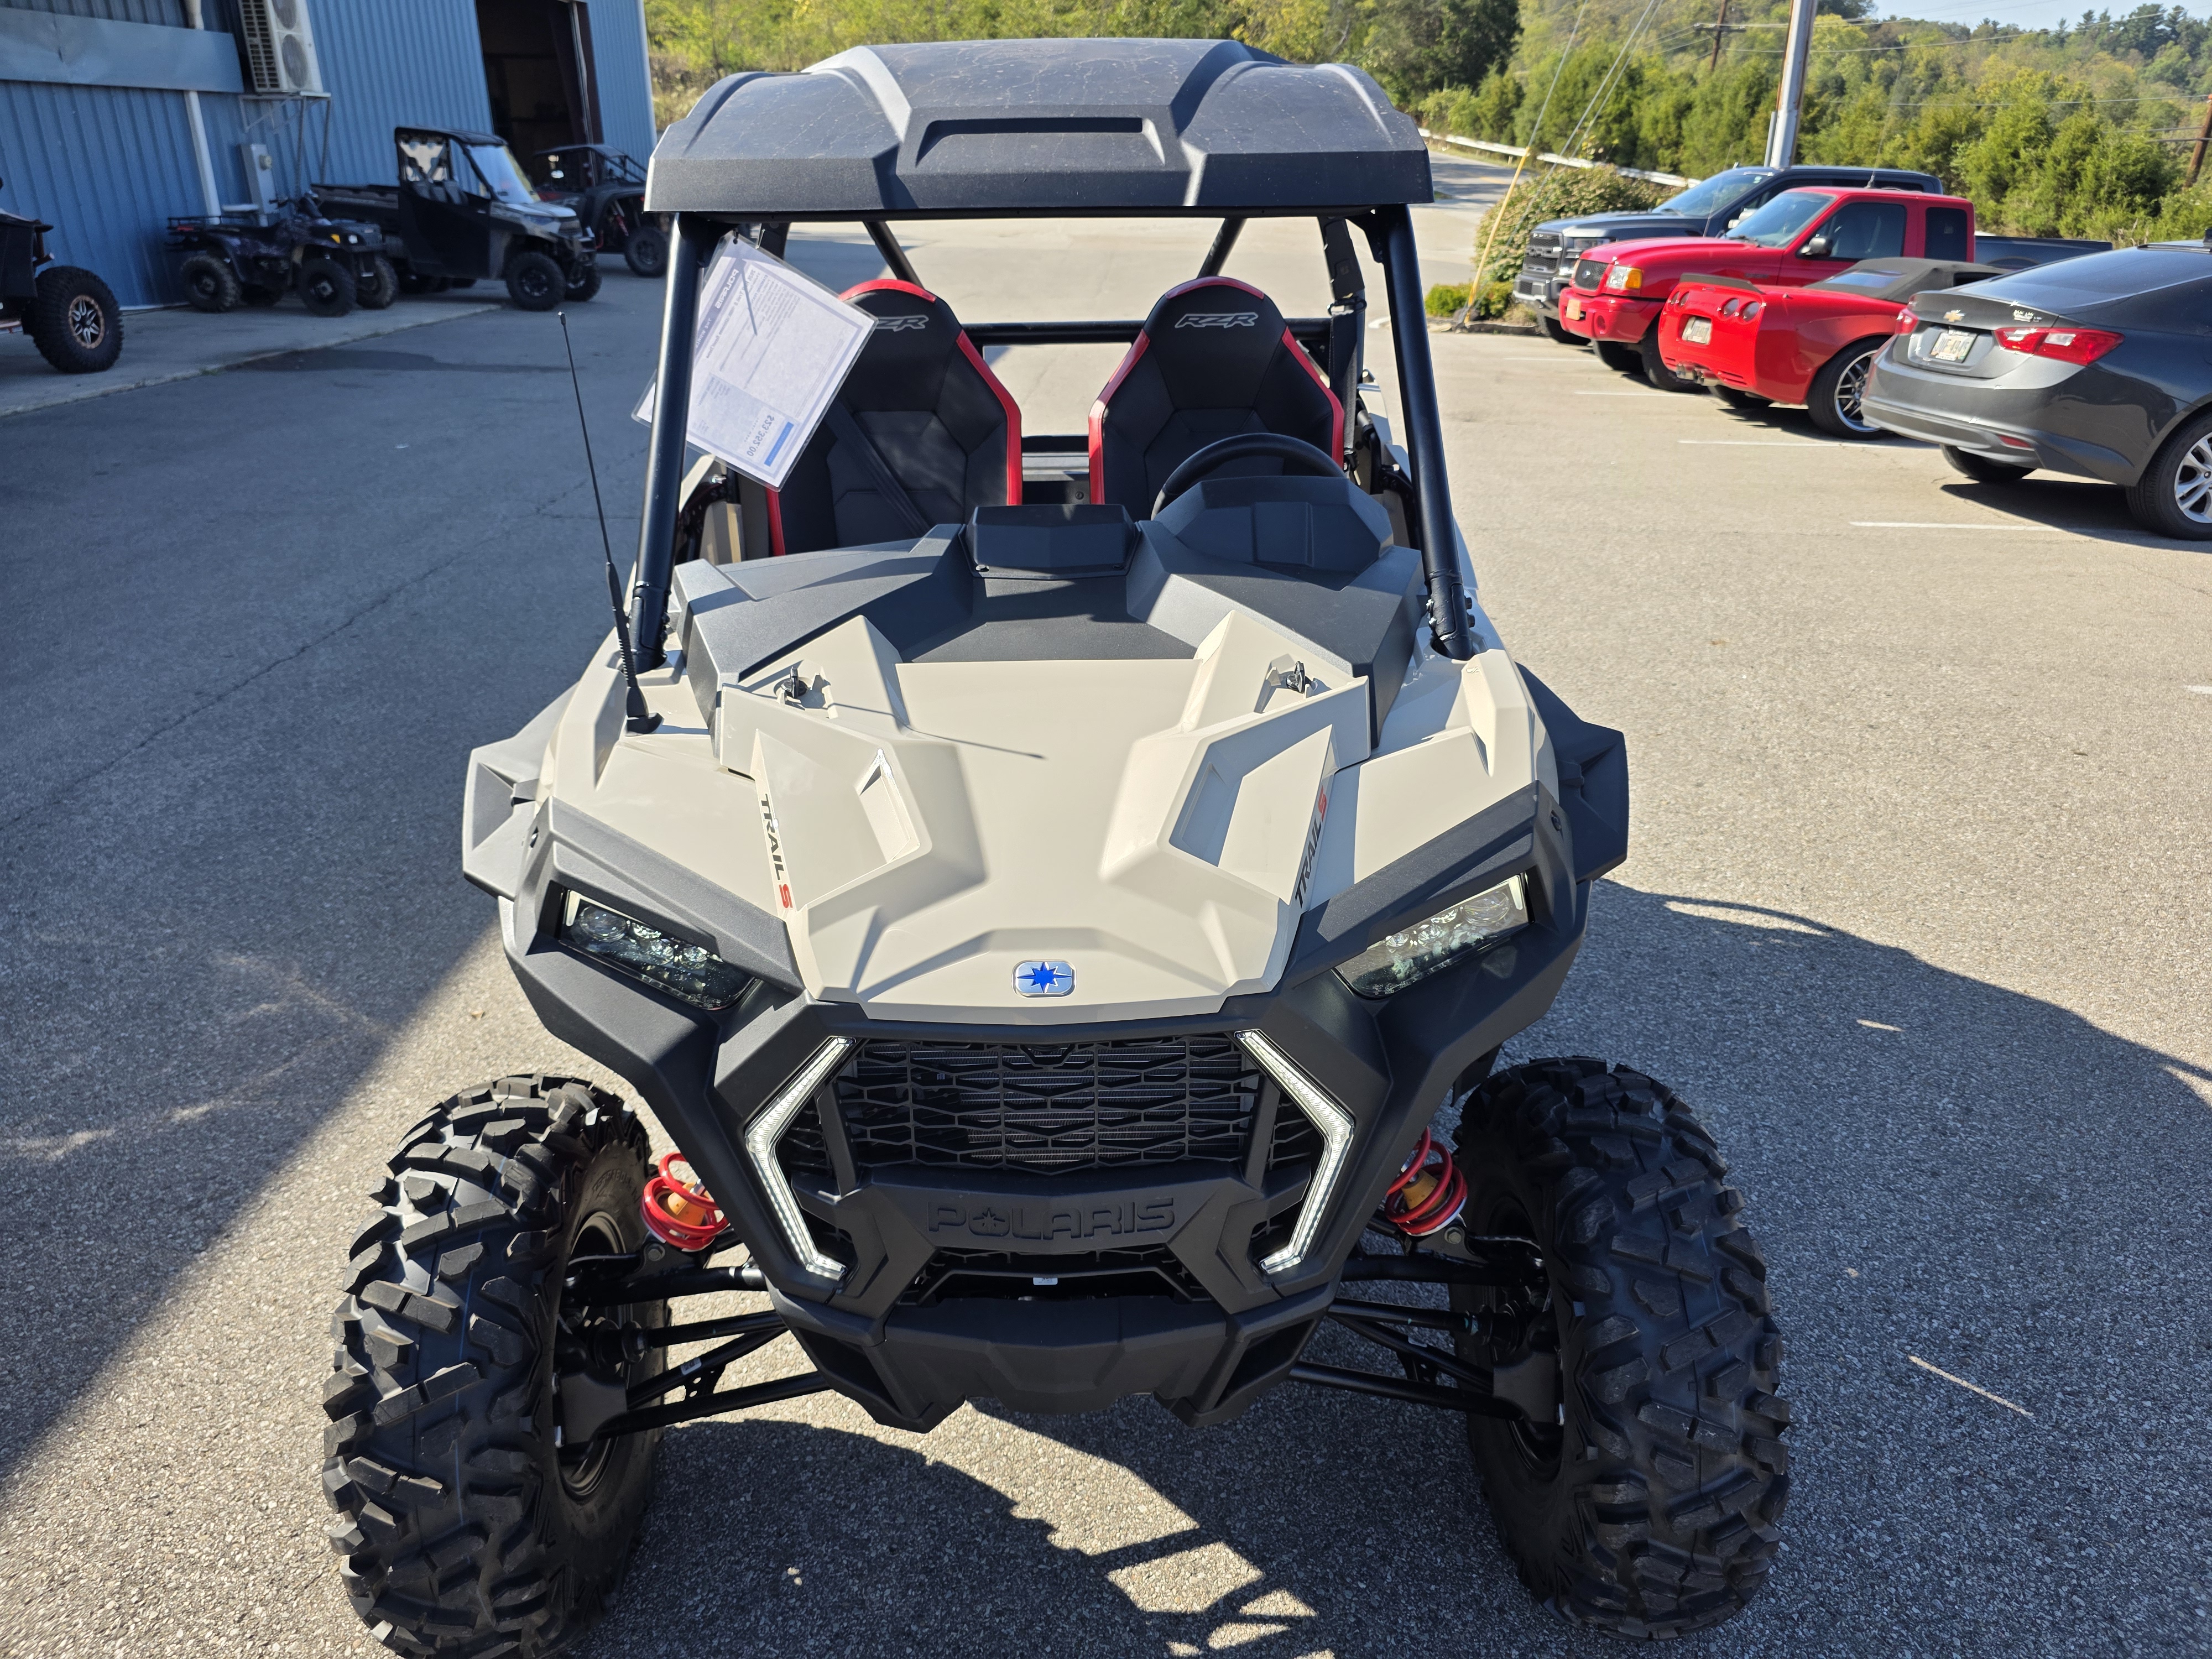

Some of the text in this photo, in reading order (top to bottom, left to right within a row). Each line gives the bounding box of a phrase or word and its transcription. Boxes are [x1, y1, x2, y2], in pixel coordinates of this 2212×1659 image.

[877, 315, 930, 332] ZR
[1175, 312, 1259, 328] RZR
[760, 793, 793, 909] TRAIL S
[1295, 785, 1327, 908] TRAIL S
[927, 1197, 1175, 1240] POLARIS
